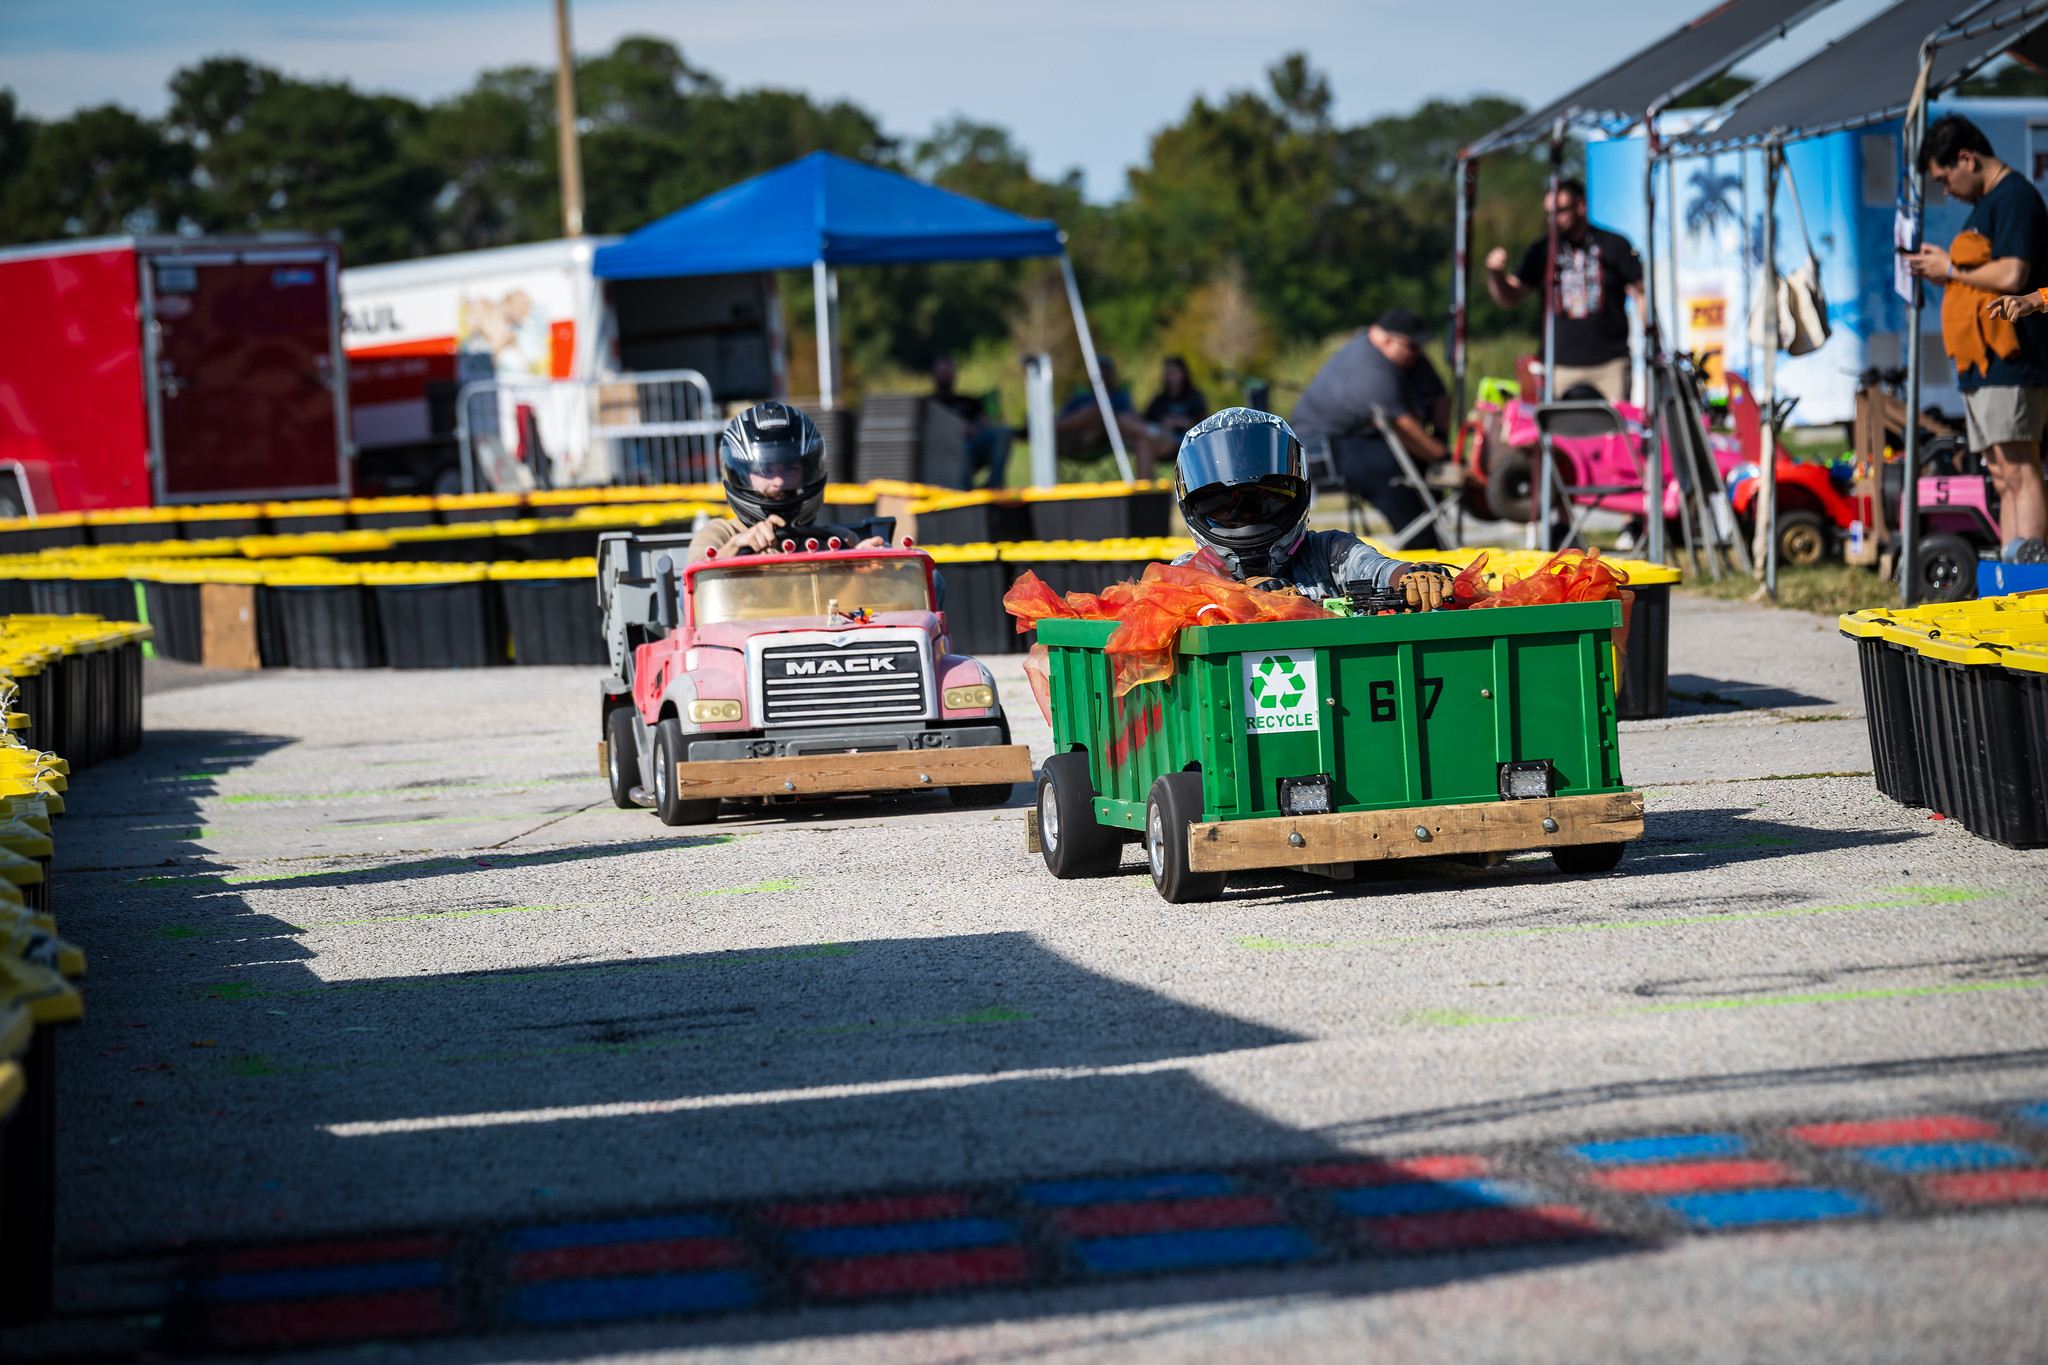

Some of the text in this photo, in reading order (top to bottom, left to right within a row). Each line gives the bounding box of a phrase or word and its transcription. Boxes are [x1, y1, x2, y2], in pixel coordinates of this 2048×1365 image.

[340, 305, 405, 334] AUL
[1936, 480, 1949, 505] 5
[786, 657, 896, 676] MACK
[1246, 713, 1313, 730] RECYCLE
